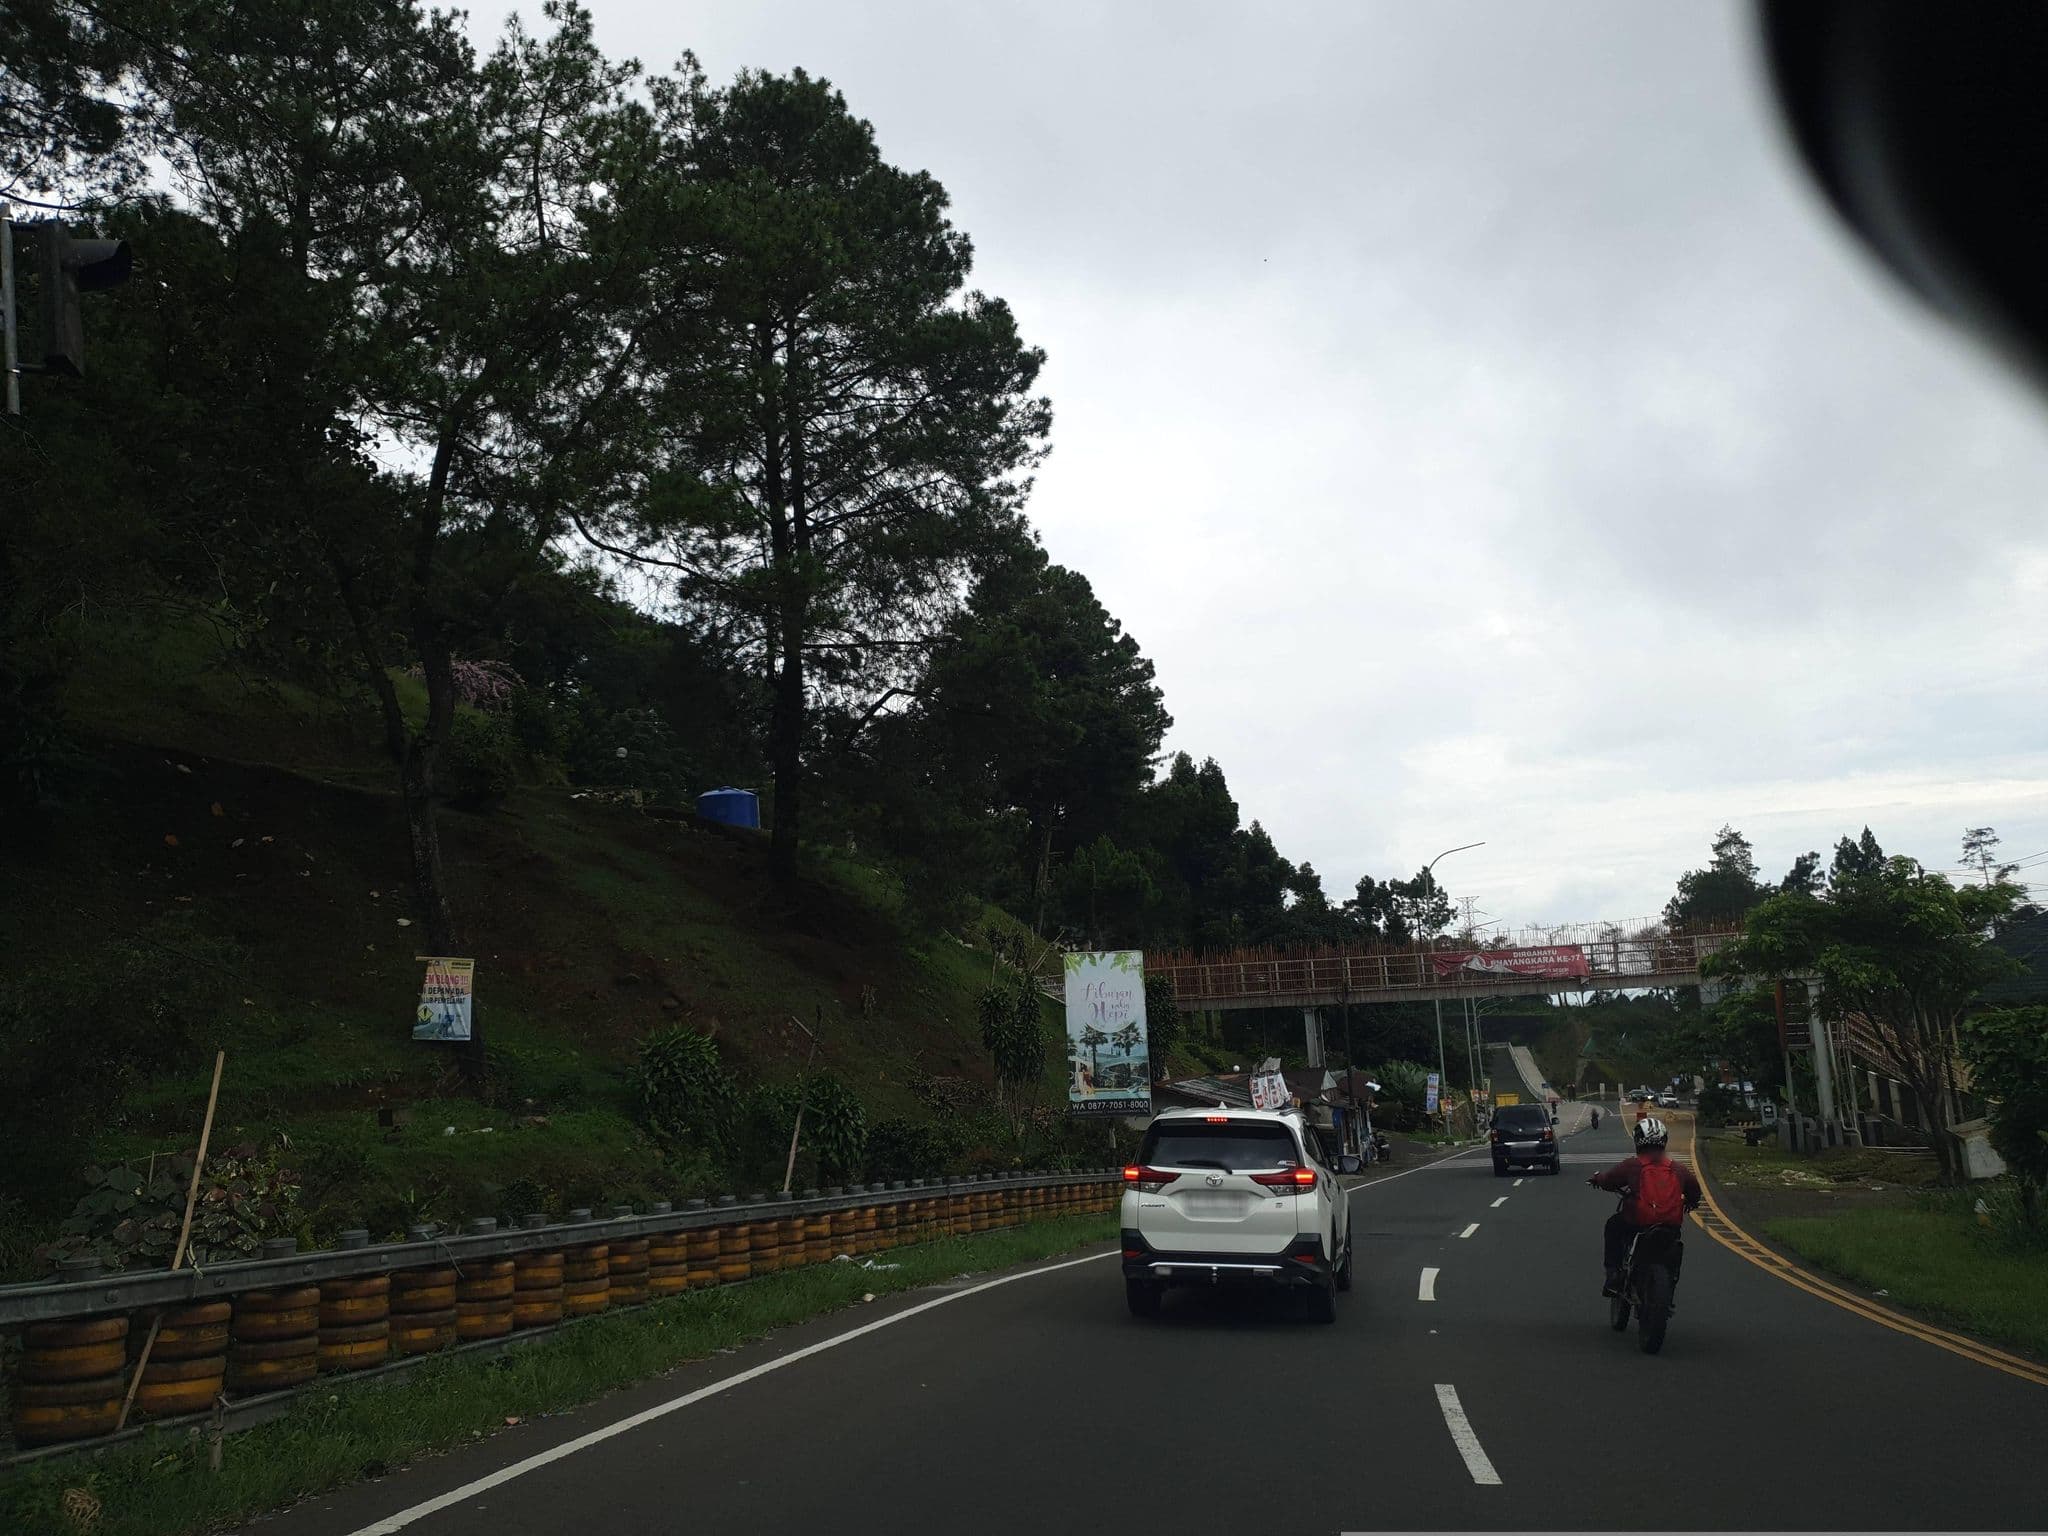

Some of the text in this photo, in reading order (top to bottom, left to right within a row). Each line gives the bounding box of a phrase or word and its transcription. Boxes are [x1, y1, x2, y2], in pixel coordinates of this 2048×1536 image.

[1513, 949, 1557, 958] DIRGAHAYU
[1556, 954, 1580, 963] KE-77
[436, 974, 459, 985] BLONG
